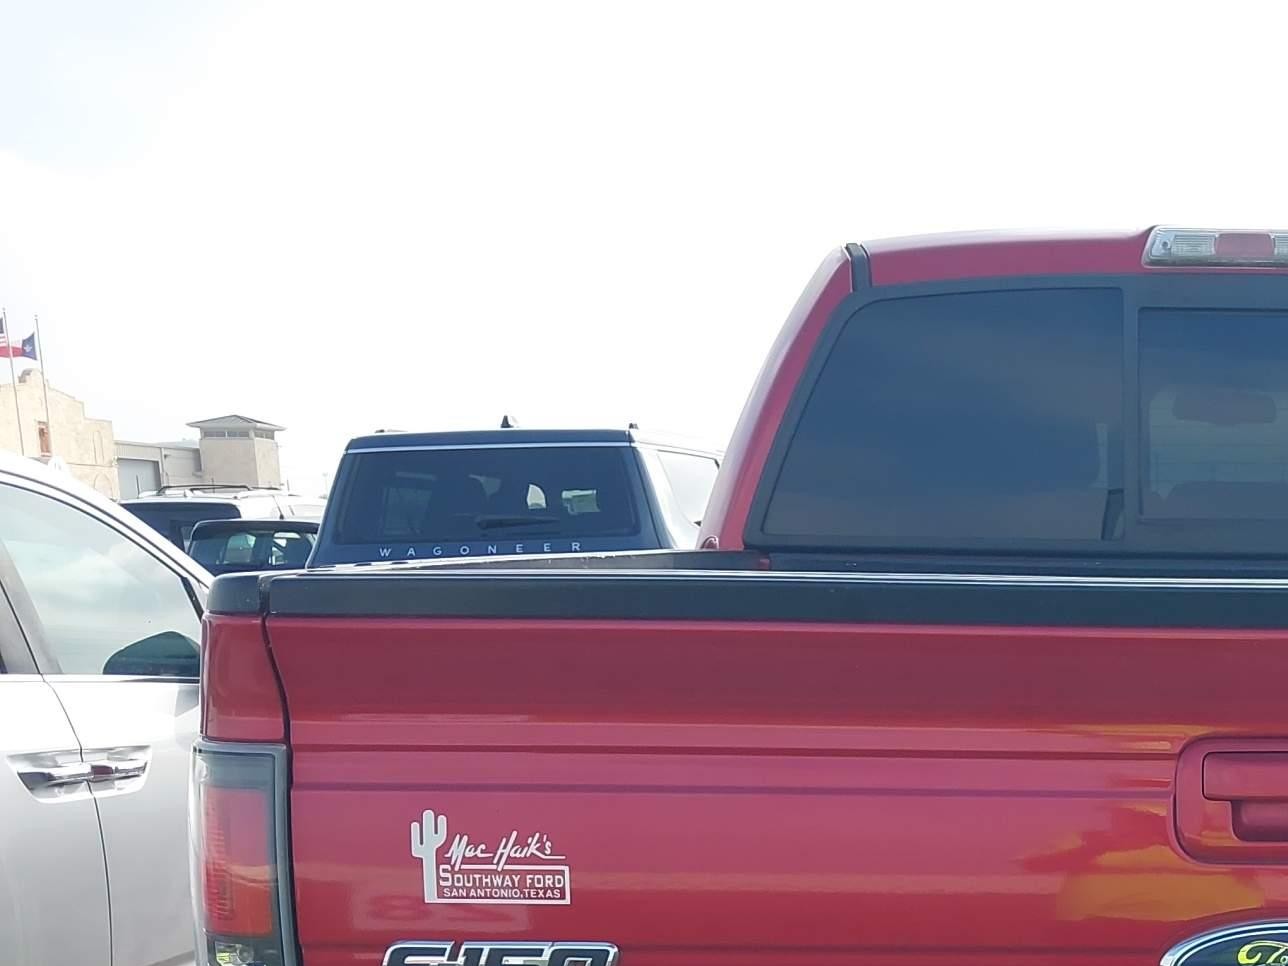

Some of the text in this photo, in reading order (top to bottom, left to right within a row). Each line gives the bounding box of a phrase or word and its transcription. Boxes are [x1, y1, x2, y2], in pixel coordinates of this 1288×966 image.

[378, 541, 582, 558] WAGONEER
[444, 830, 566, 872] Mac Haik's
[439, 865, 564, 888] SOUTHWAY FORD
[443, 888, 467, 897] SAN
